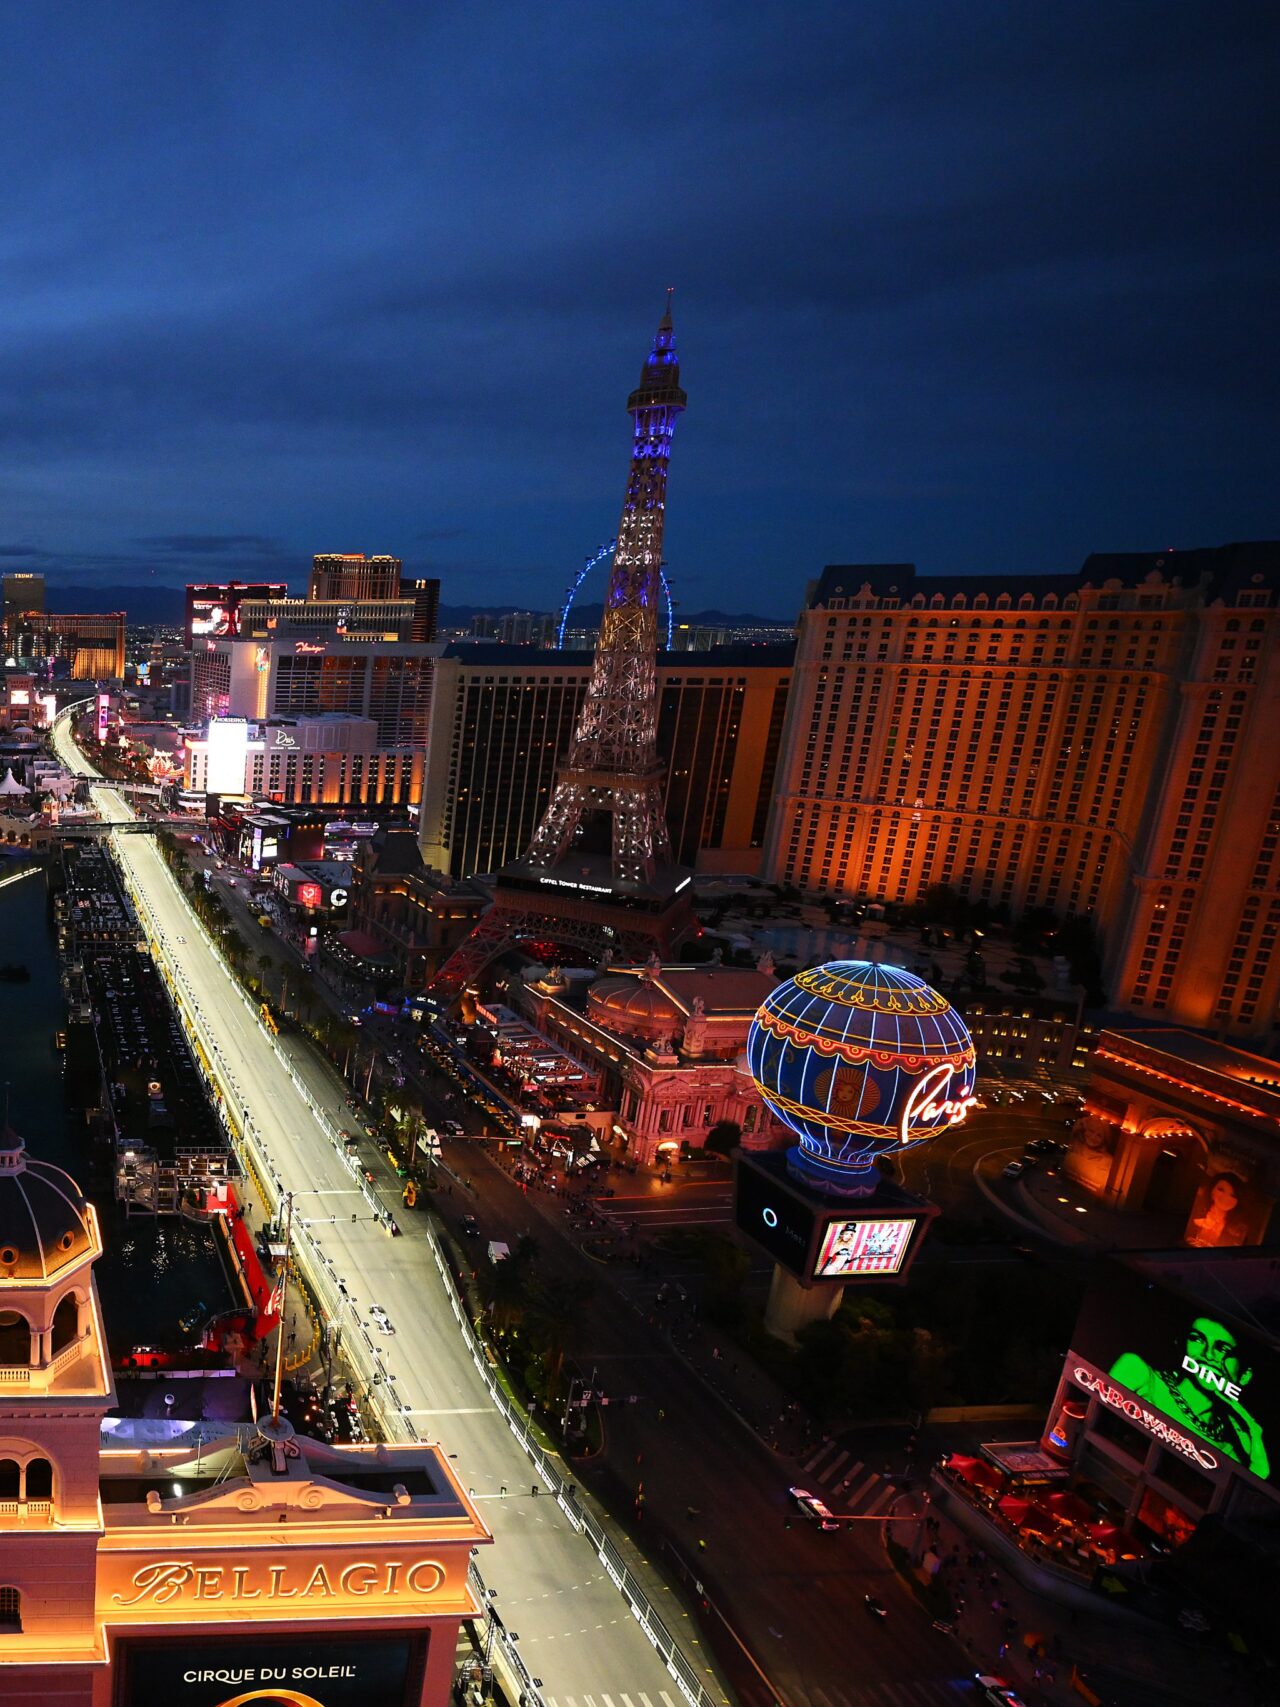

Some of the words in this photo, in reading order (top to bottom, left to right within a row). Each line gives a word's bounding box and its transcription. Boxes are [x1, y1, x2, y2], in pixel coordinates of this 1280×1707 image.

[559, 880, 577, 888] TOWER
[579, 883, 612, 893] RESTAURANT
[902, 1063, 977, 1144] Paris
[1181, 1355, 1242, 1401] DINE
[111, 1561, 447, 1605] BELLAGIO
[183, 1669, 255, 1685] CIRQUE
[260, 1668, 286, 1680] DU
[291, 1665, 356, 1680] SOLEIL
